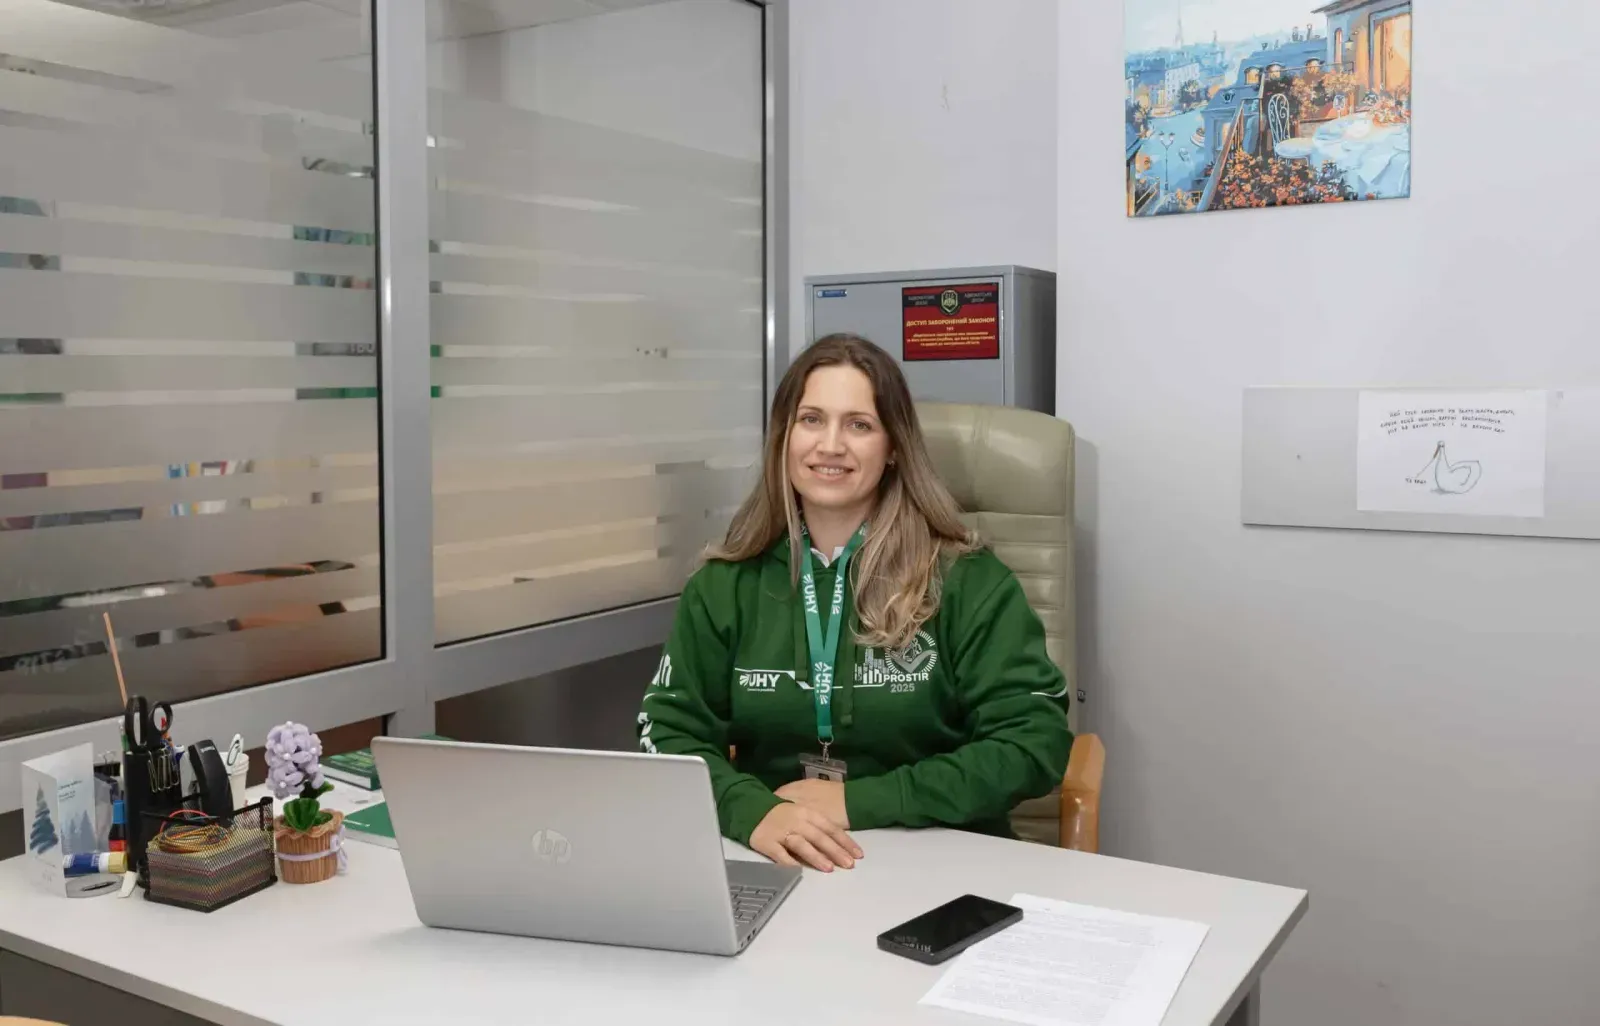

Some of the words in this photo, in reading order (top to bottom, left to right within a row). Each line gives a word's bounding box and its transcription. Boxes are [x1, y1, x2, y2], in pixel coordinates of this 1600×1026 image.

[906, 319, 928, 327] ДОСТУП
[928, 317, 967, 325] ЗАБОРОНЕНИЙ
[969, 316, 995, 324] ЗАКОНОМ
[804, 584, 818, 614] UHY
[833, 574, 843, 604] UHY
[749, 673, 781, 688] UHY
[820, 662, 832, 694] UHY
[884, 672, 929, 683] PROSTIR
[890, 683, 916, 693] 2025
[534, 828, 570, 867] hp
